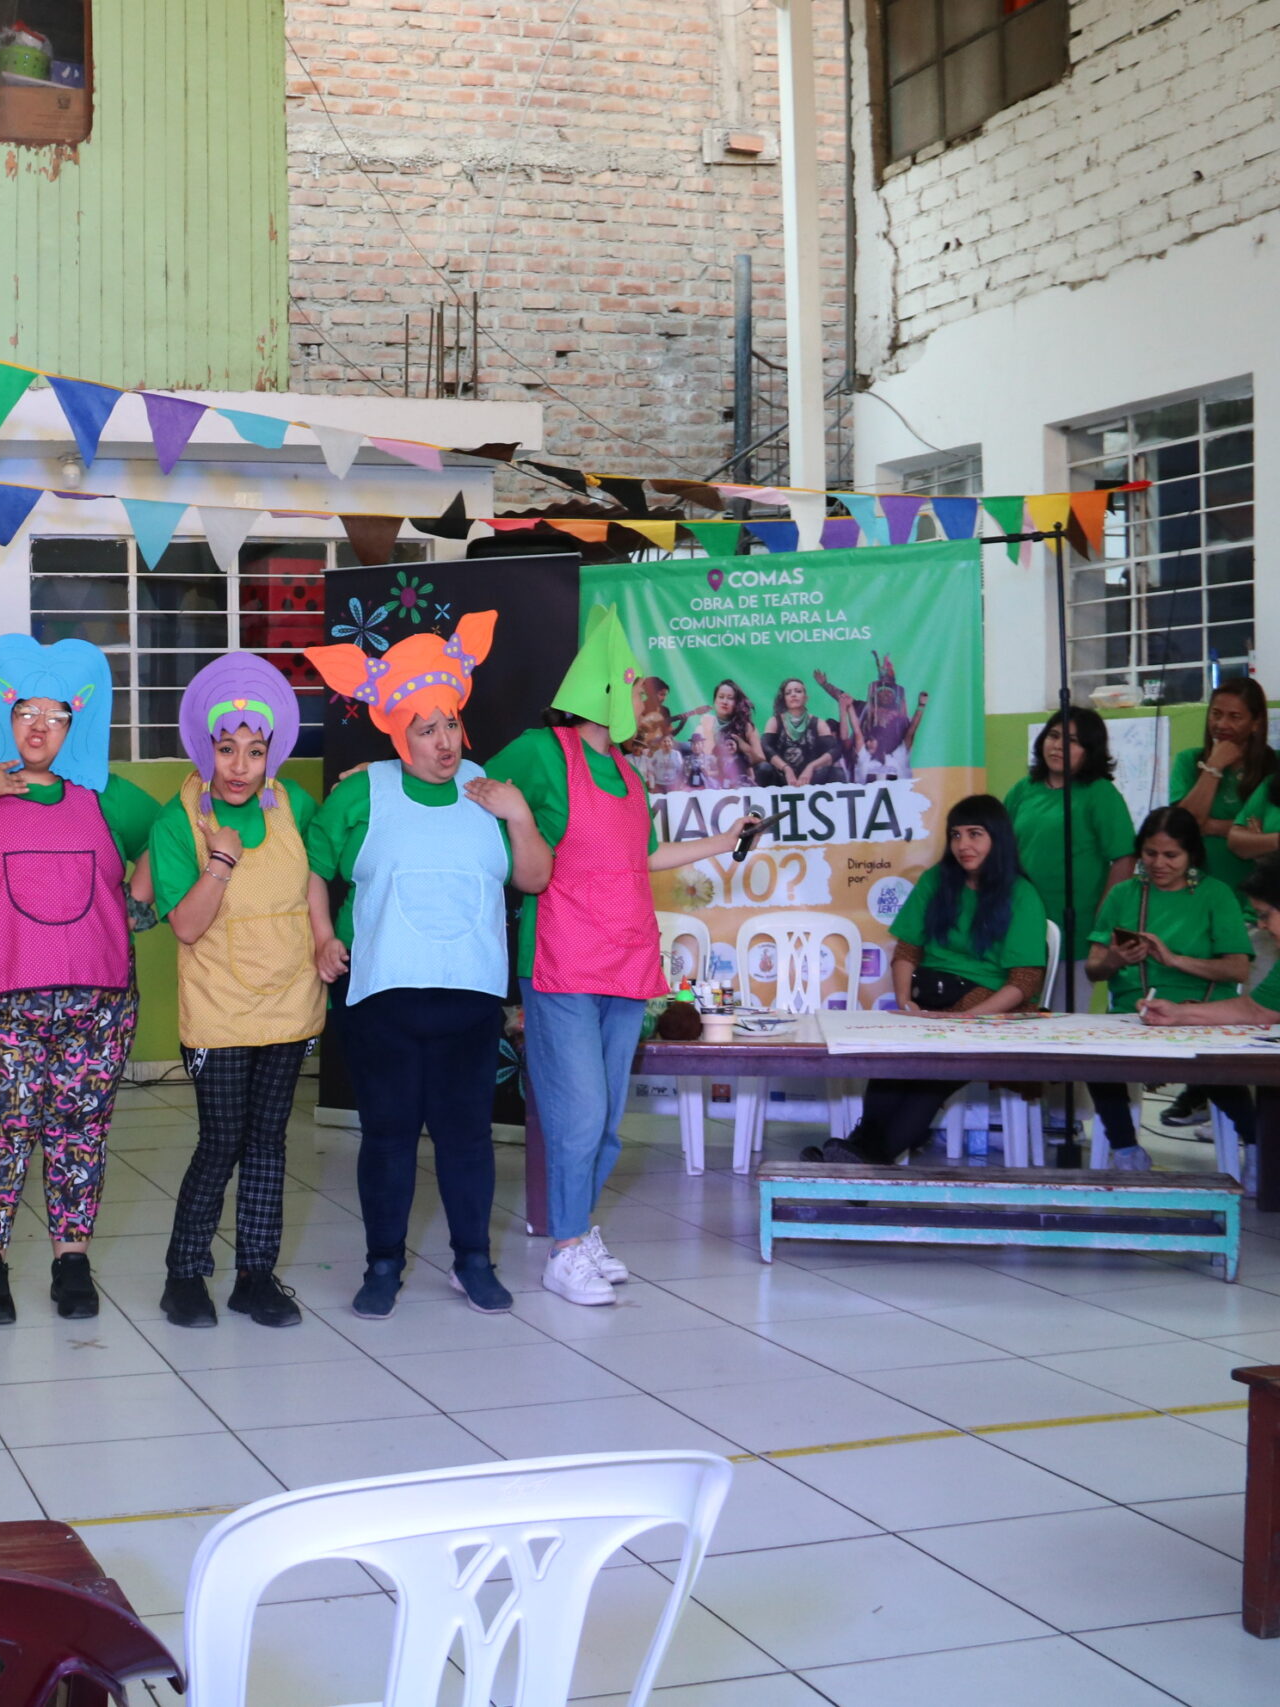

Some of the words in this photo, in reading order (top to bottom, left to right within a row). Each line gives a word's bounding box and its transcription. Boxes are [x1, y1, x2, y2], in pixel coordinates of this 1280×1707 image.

[728, 568, 804, 588] COMAS
[690, 596, 734, 611] OBRA
[738, 595, 759, 609] DE
[763, 591, 824, 607] TEATRO
[669, 612, 776, 631] COMUNITARIA
[780, 610, 821, 625] PARA
[826, 608, 847, 622] LA
[648, 630, 746, 649] PREVENCIÓN
[750, 631, 771, 645] DE
[774, 626, 871, 642] VIOLENCIAS
[847, 858, 892, 874] Dirigida
[708, 853, 808, 903] YO?
